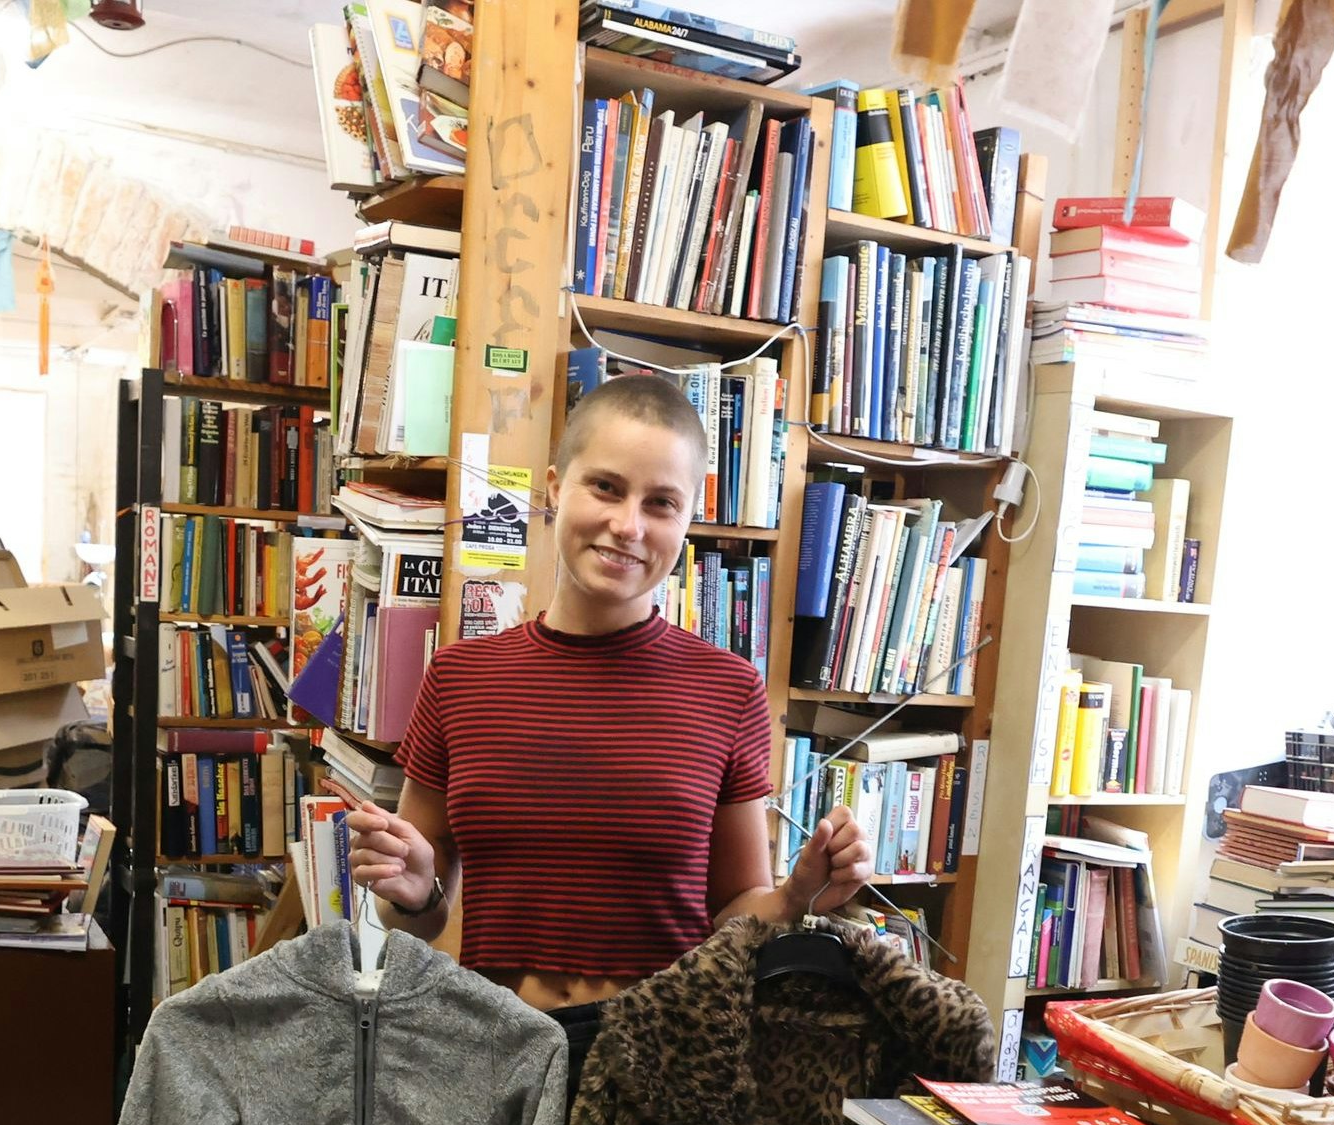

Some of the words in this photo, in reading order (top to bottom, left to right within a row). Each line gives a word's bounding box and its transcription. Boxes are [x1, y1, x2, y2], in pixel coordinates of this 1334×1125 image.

[581, 126, 595, 153] Peru
[789, 217, 798, 249] MOSKAU
[856, 244, 870, 325] Monumente
[708, 446, 716, 465] Rund
[142, 508, 160, 599] ROMANE
[835, 507, 859, 582] ALHAMBRA
[404, 561, 416, 570] LA
[937, 621, 948, 664] PATRICIA
[943, 595, 951, 618] SHAW
[1034, 625, 1059, 778] ENGLISH
[1111, 741, 1124, 780] German
[969, 745, 987, 839] REISEN
[906, 795, 920, 829] Thailand
[1013, 822, 1041, 975] FRANÇAIS
[173, 916, 182, 948] Quipu
[1043, 1091, 1080, 1103] TUN?
